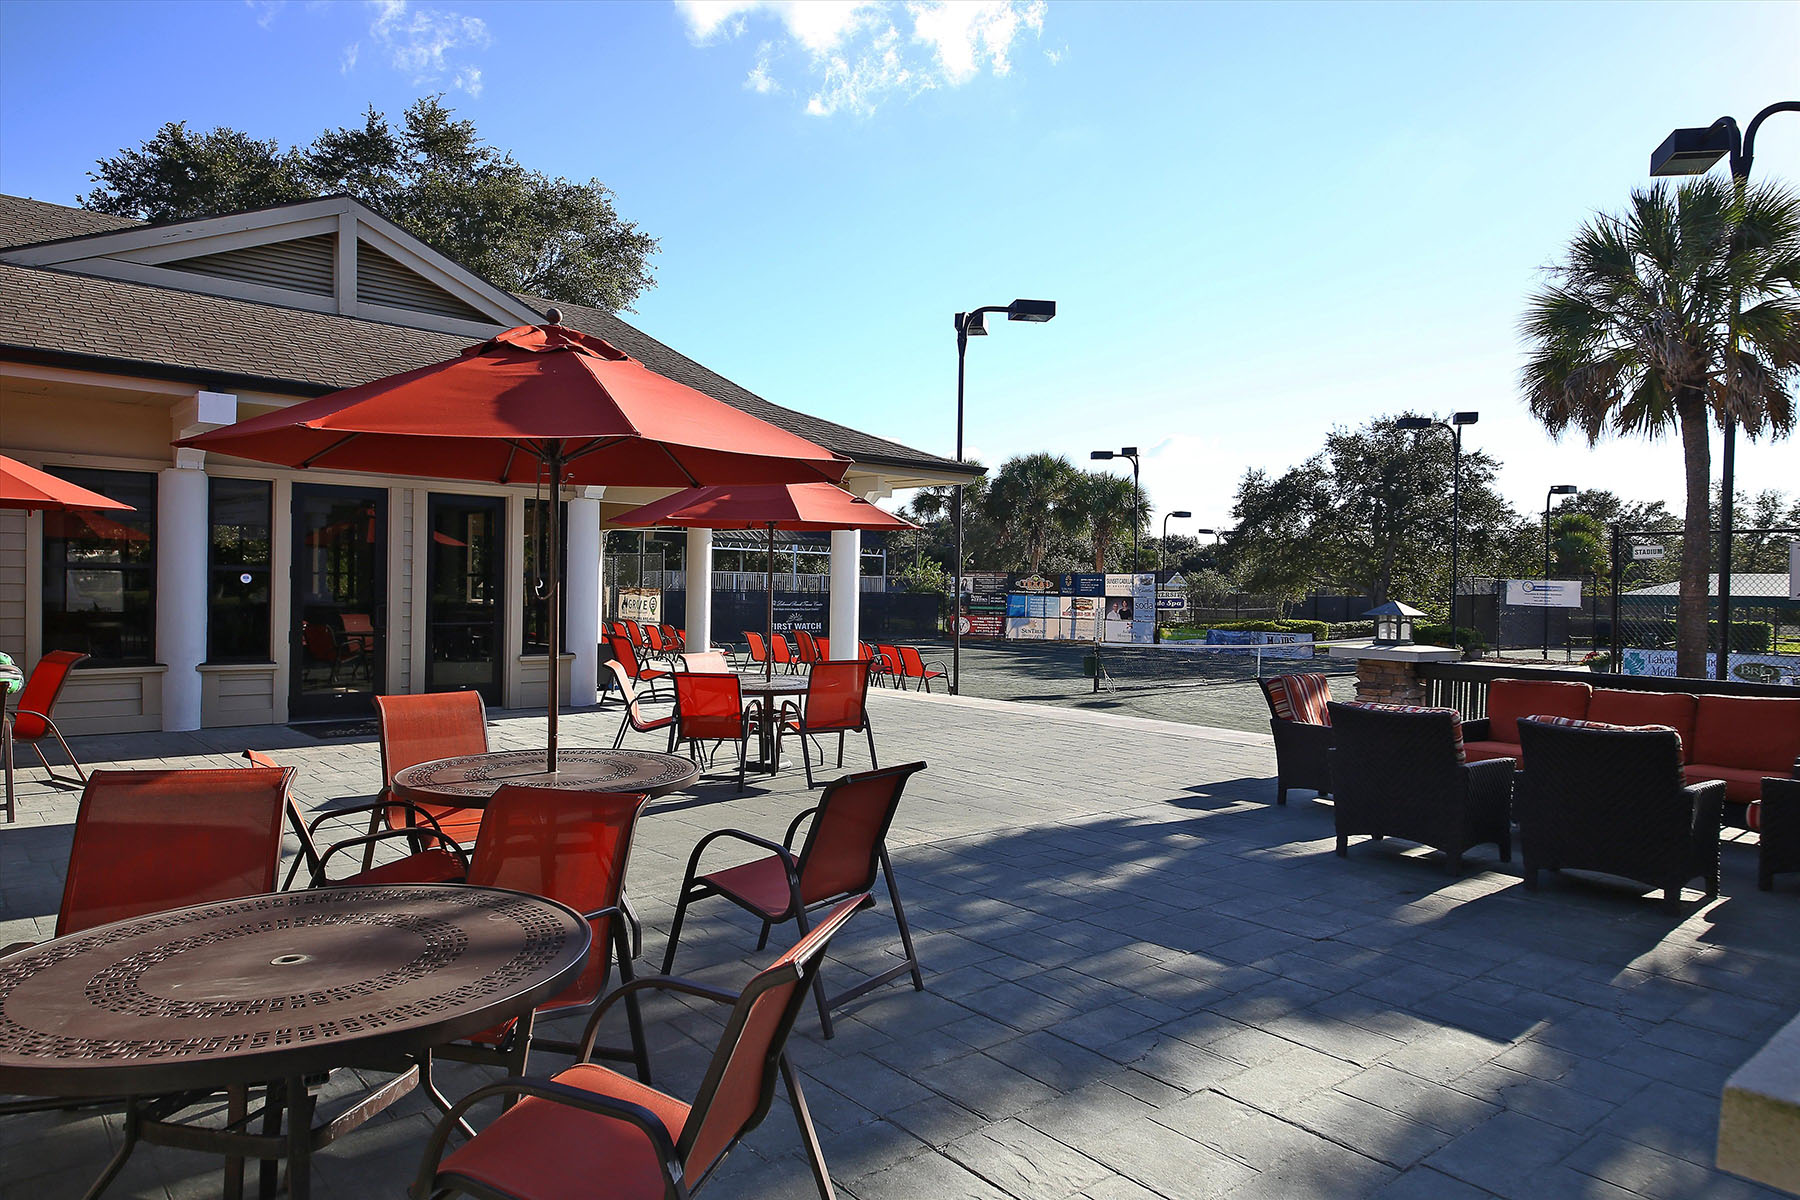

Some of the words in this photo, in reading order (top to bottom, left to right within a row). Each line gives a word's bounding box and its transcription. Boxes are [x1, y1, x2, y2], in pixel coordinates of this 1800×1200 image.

[1135, 599, 1153, 610] soda
[794, 622, 822, 630] WATCH
[1648, 654, 1677, 665] Lakew
